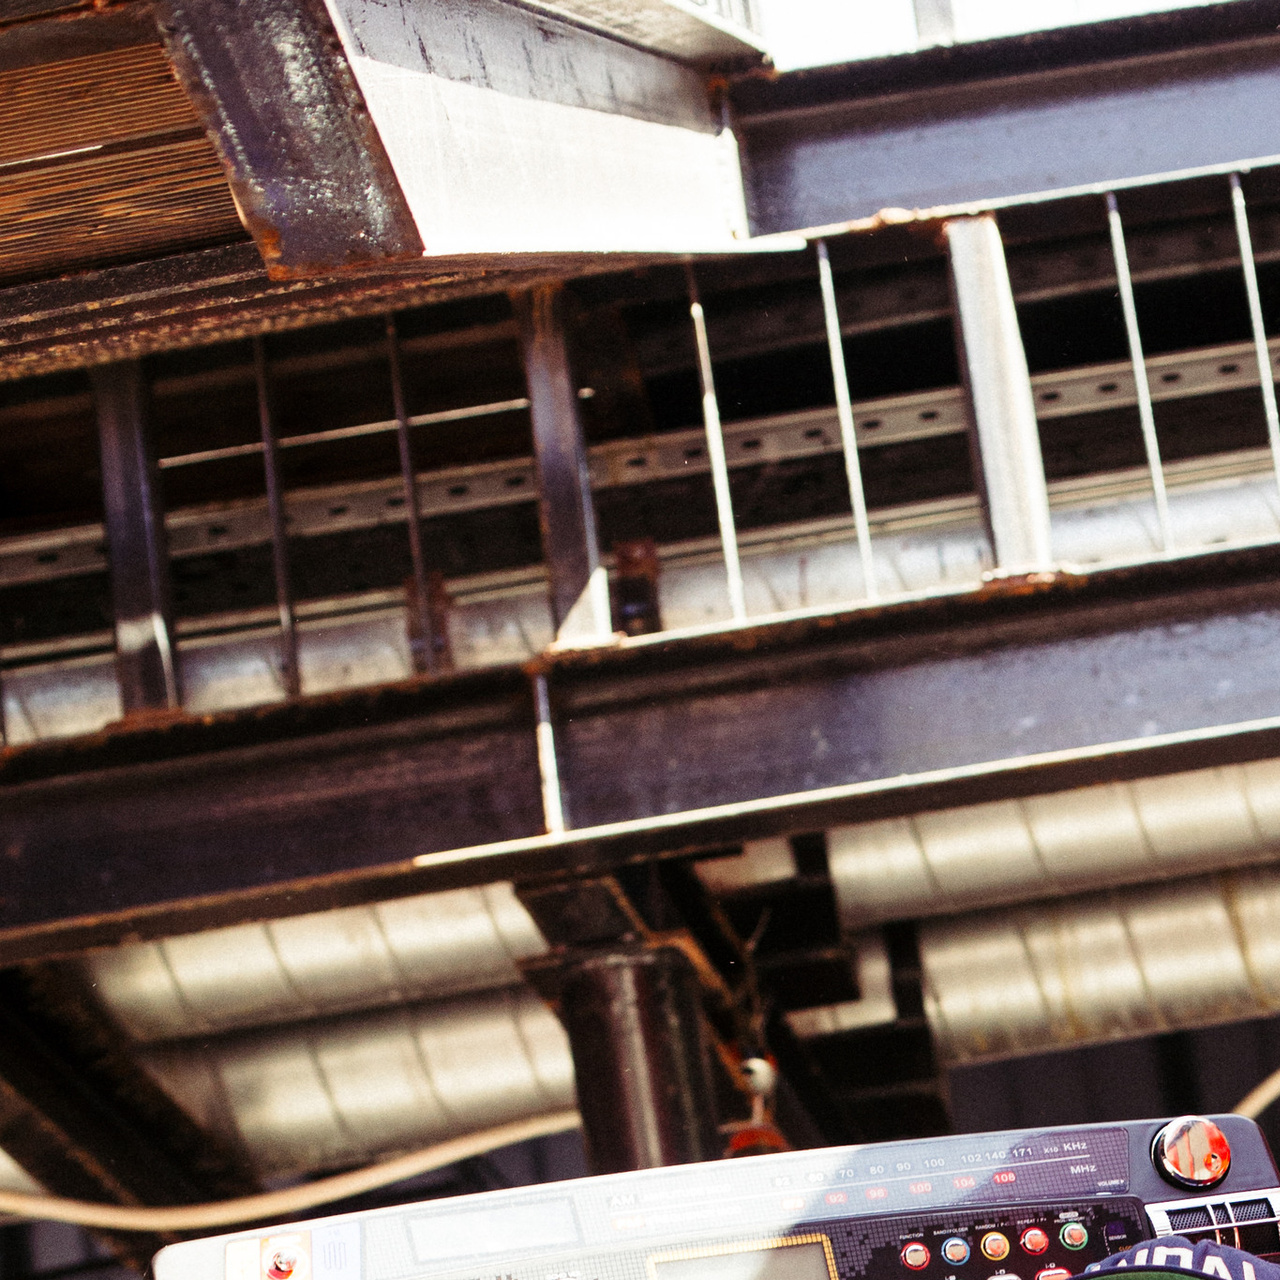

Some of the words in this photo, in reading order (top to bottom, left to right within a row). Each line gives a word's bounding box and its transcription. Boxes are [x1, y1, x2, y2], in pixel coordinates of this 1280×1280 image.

[839, 1169, 854, 1178] 70
[869, 1165, 884, 1175] 80
[896, 1162, 911, 1171] 90
[924, 1158, 945, 1168] 100
[985, 1151, 1006, 1160] 140
[1013, 1147, 1033, 1157] 171
[1063, 1141, 1088, 1151] KHz
[911, 1183, 931, 1193] 100
[956, 1177, 976, 1188] 104
[995, 1173, 1015, 1183] 108
[1070, 1164, 1097, 1174] MHz
